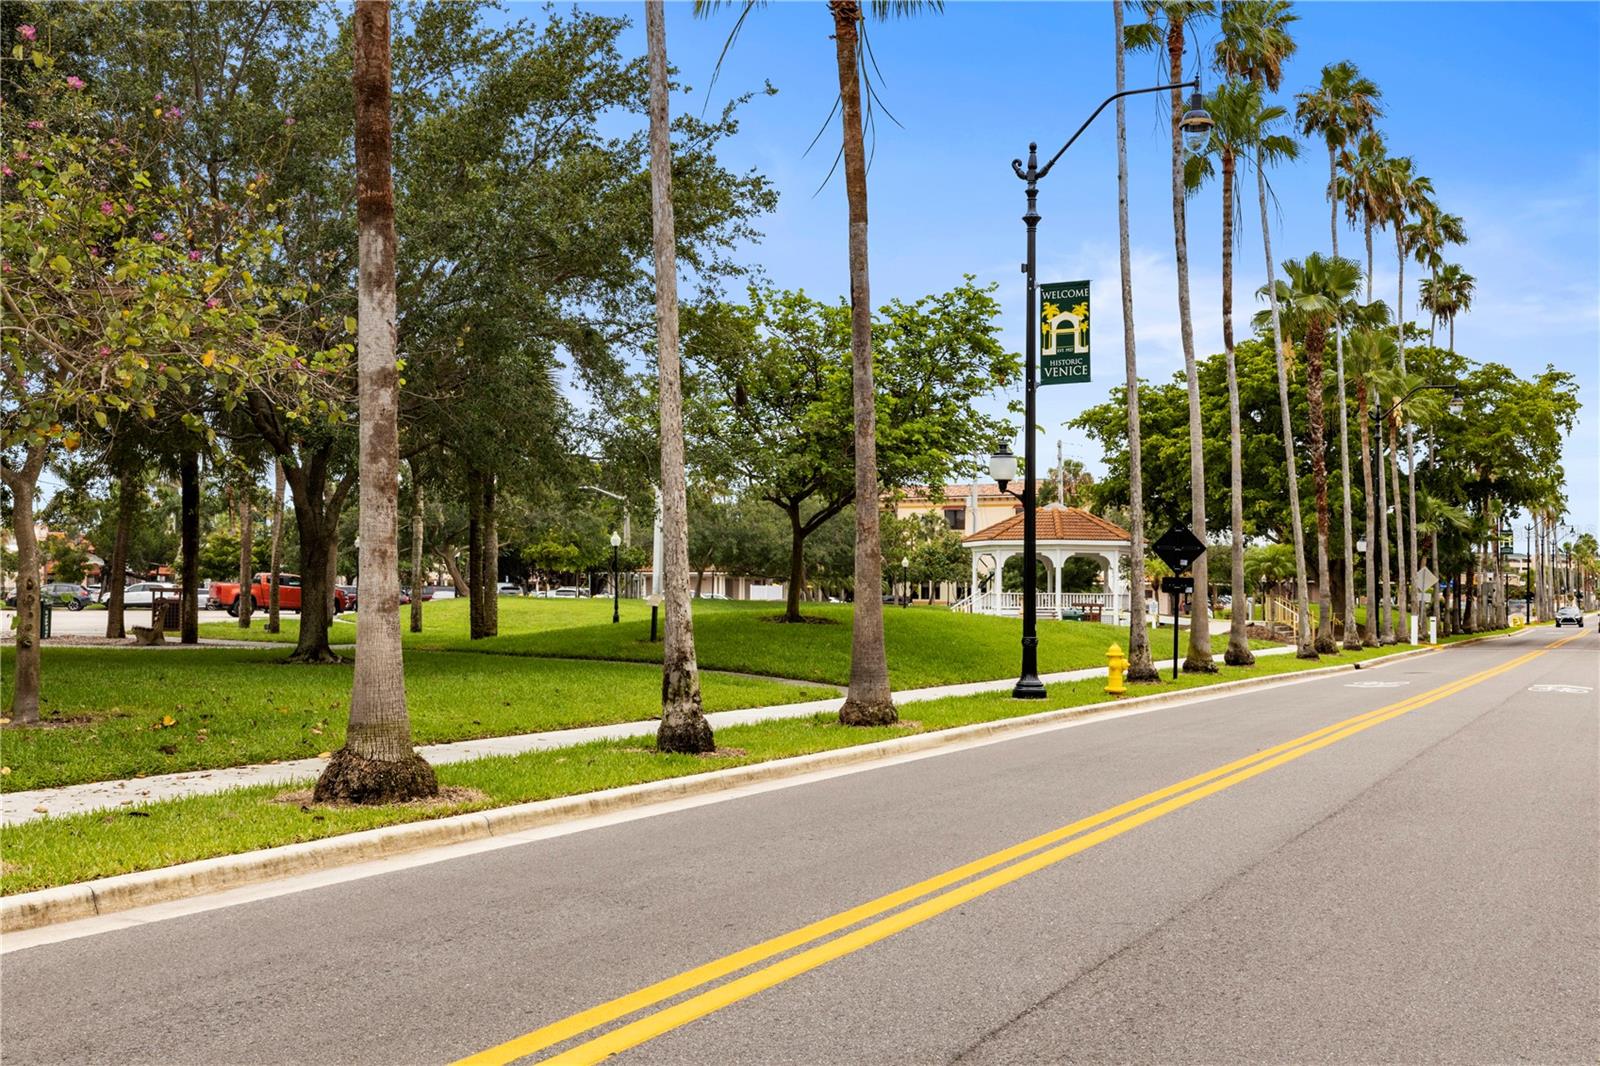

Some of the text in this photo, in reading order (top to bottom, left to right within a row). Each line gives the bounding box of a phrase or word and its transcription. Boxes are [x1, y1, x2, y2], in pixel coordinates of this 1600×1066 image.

[1042, 288, 1089, 299] WELCOME
[1050, 358, 1083, 367] HISTORIC
[1044, 365, 1088, 377] VENICE
